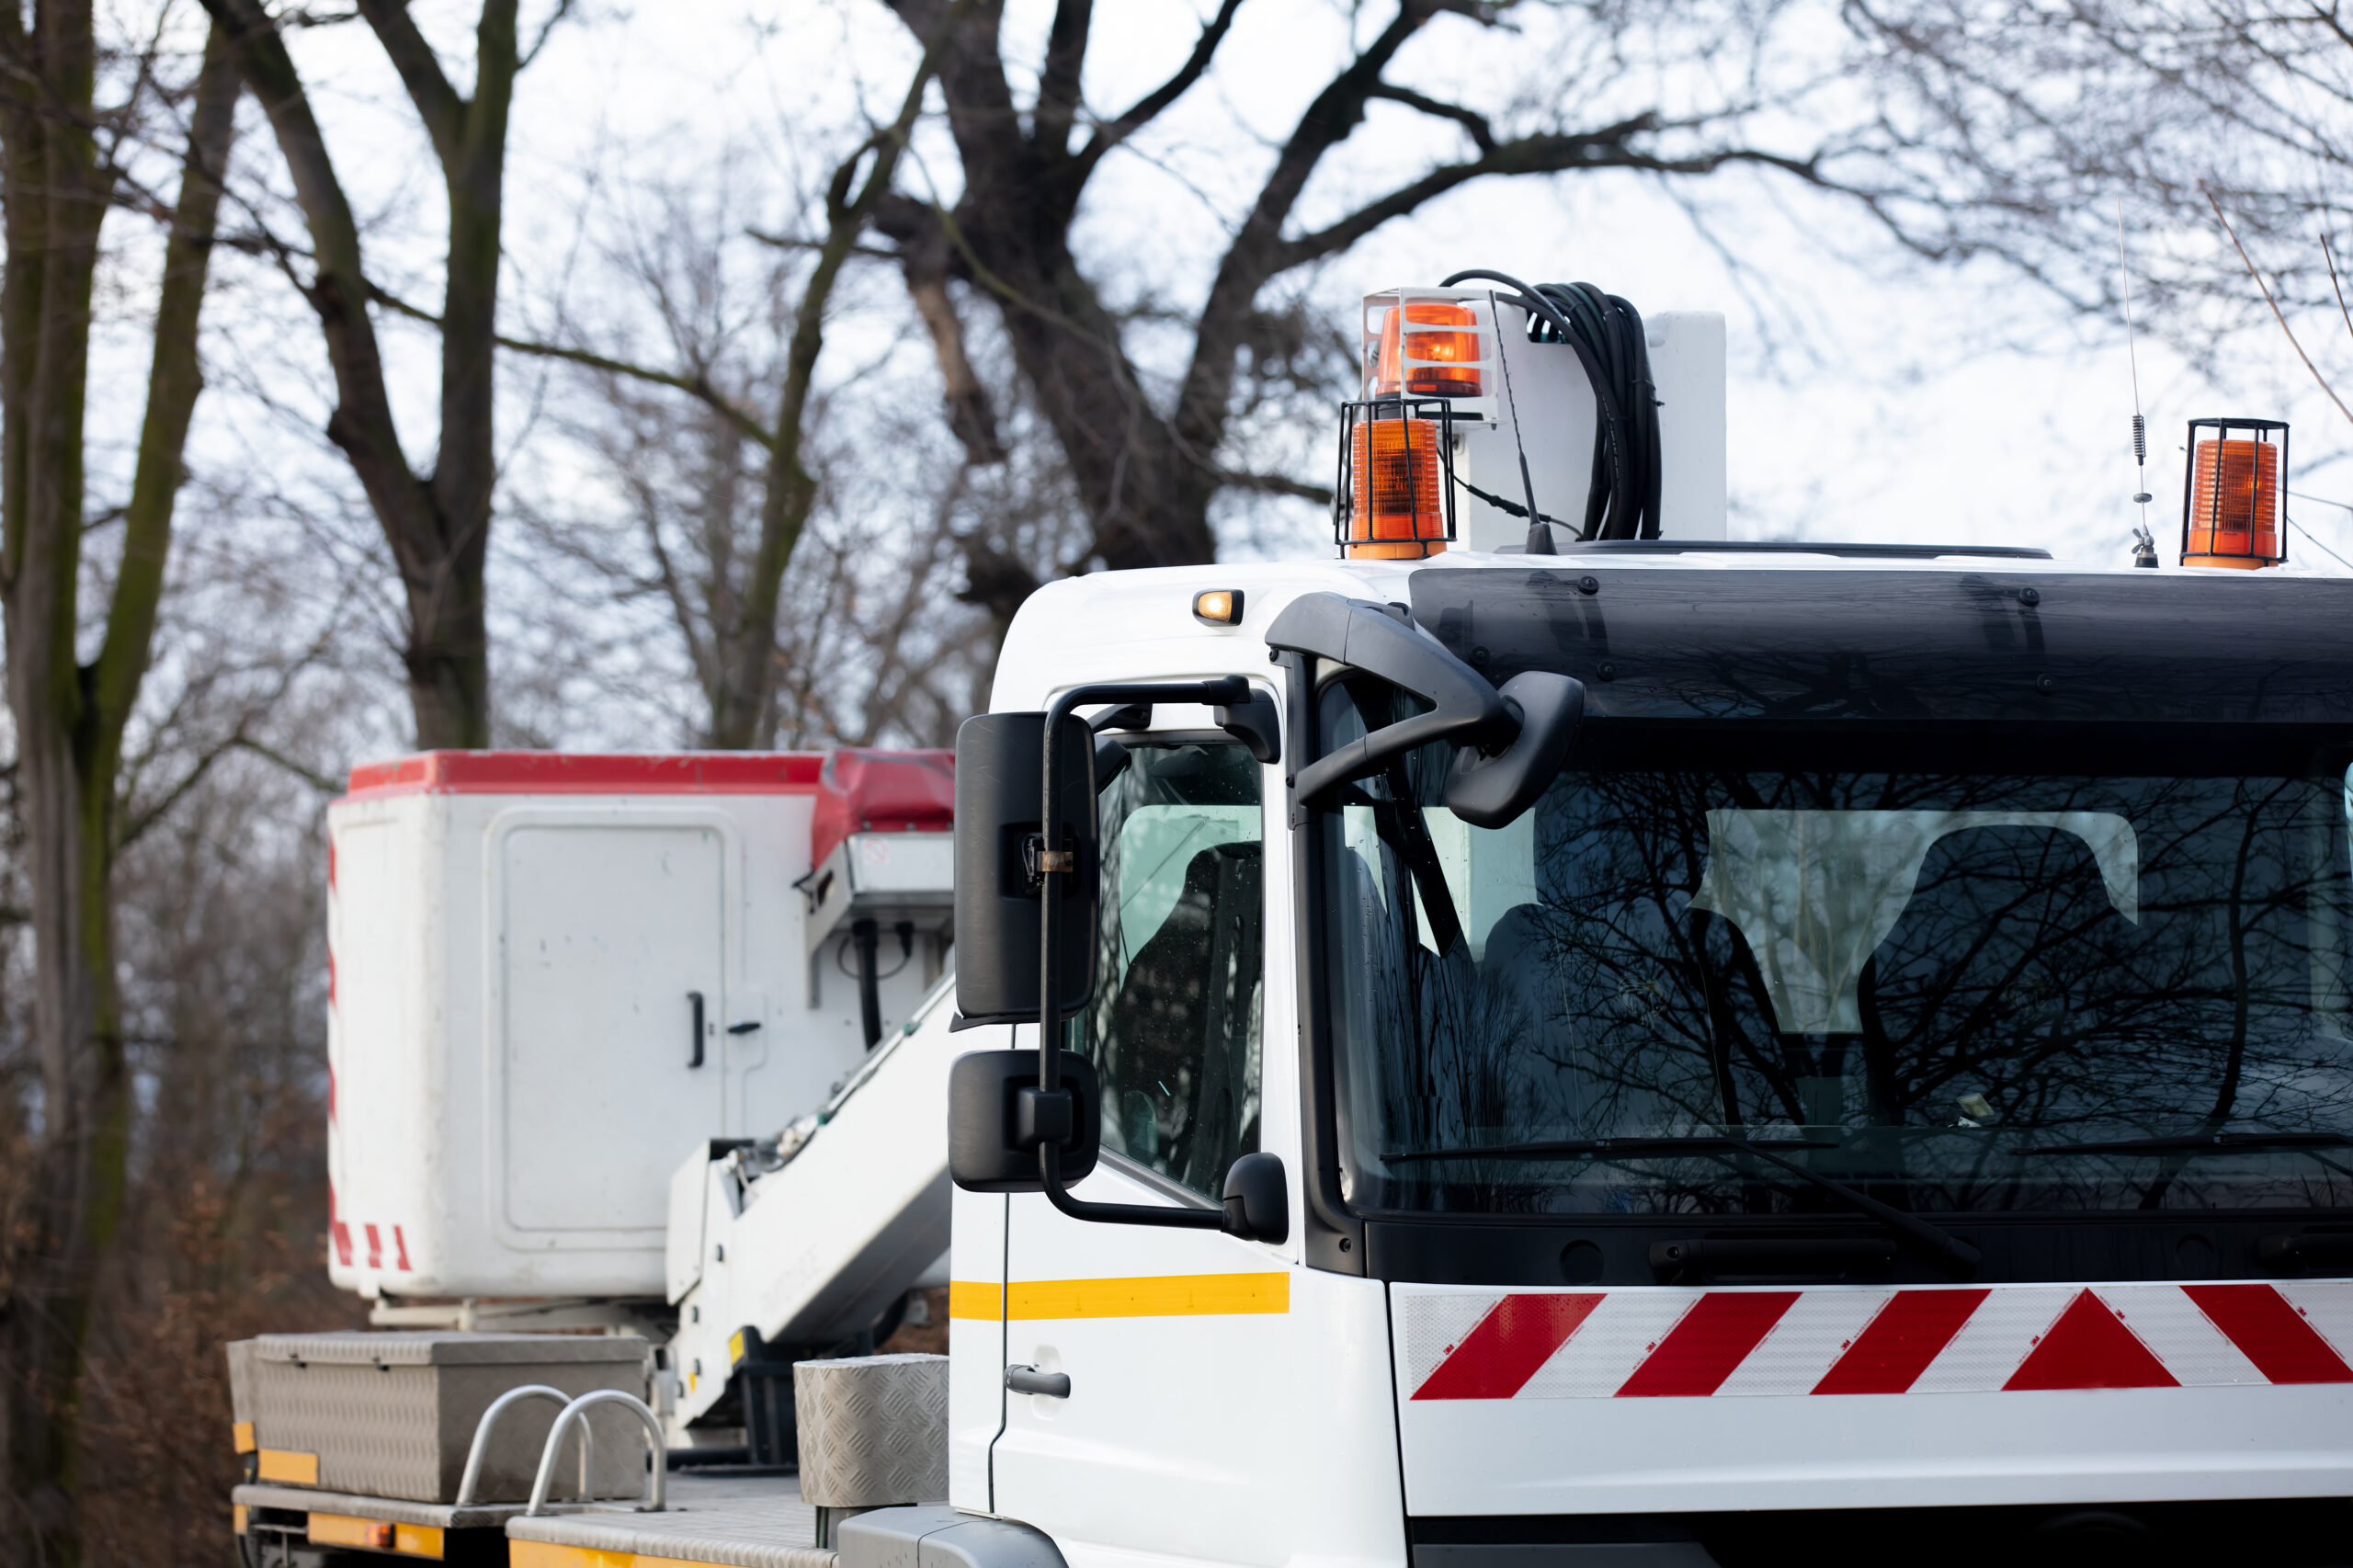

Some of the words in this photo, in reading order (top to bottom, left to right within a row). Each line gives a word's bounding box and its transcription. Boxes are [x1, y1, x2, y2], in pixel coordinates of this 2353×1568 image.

[2114, 1309, 2125, 1320] 3M
[1645, 1341, 1657, 1353] 3M
[1840, 1338, 1851, 1351] 3M
[2029, 1335, 2040, 1347] 3M
[1443, 1343, 1455, 1356] 3M
